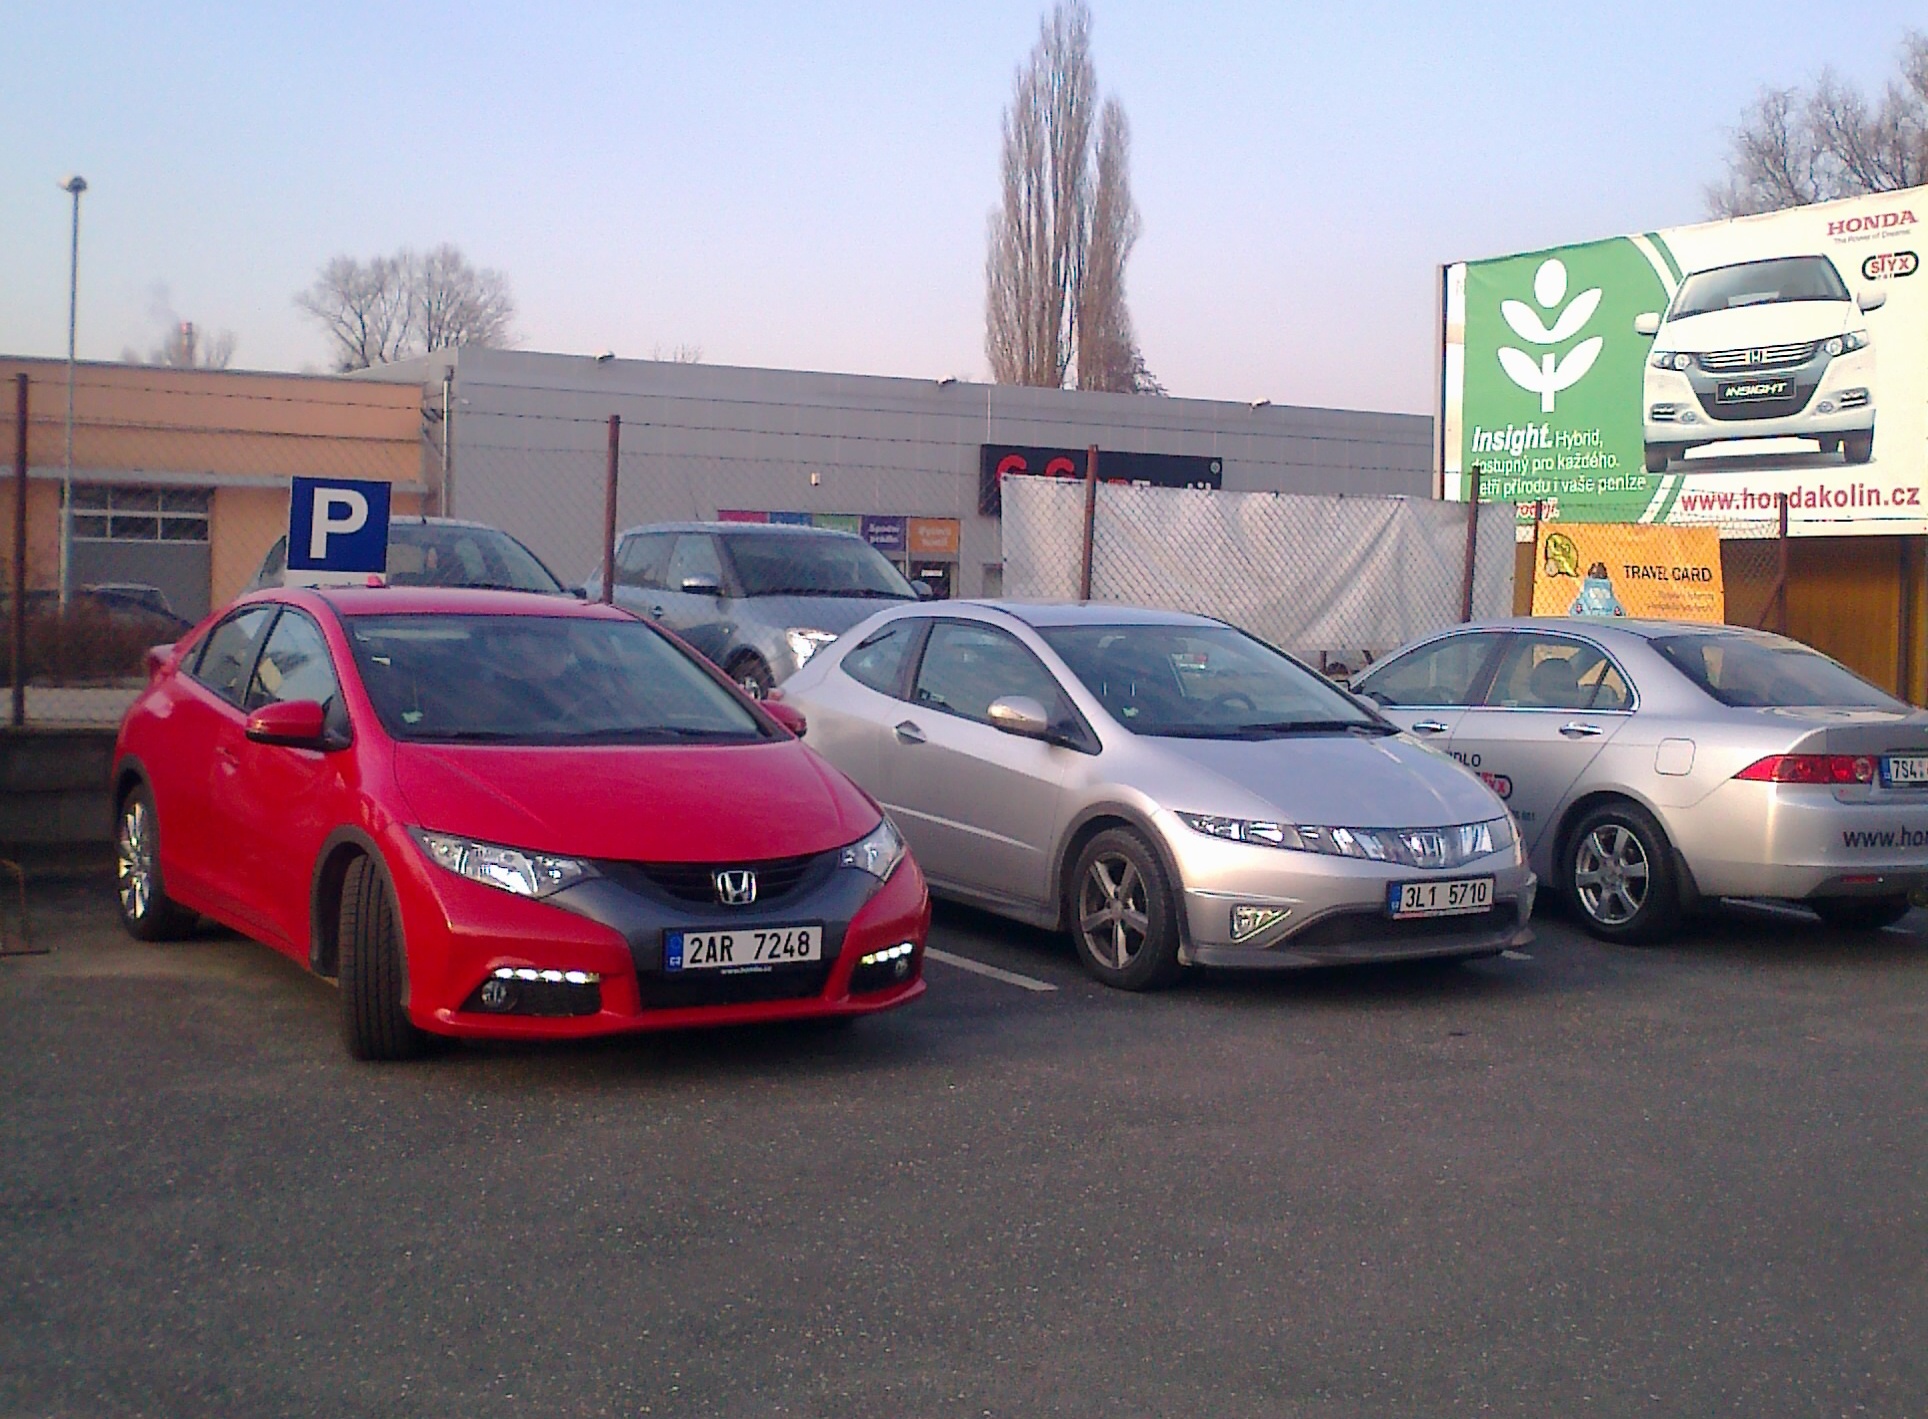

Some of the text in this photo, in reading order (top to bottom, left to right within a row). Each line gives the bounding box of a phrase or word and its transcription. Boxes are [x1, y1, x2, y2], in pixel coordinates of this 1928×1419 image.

[1826, 210, 1919, 236] HONDA
[1871, 253, 1910, 274] STYX
[1725, 382, 1788, 397] INSIGHT
[1472, 421, 1604, 456] Insight. Hybrid,
[1532, 459, 1555, 475] pro
[1558, 452, 1621, 468] každého.
[1479, 477, 1501, 496] etří
[1503, 477, 1551, 498] přírodu
[1553, 477, 1558, 492] i
[1561, 475, 1596, 493] vaše
[1681, 484, 1921, 511] www.hondakolin.cz
[310, 487, 368, 559] P
[1624, 565, 1713, 583] TRAVEL CARD
[1405, 886, 1437, 908] 3L1
[1449, 882, 1487, 905] 5710
[689, 931, 811, 965] 2AR 7248
